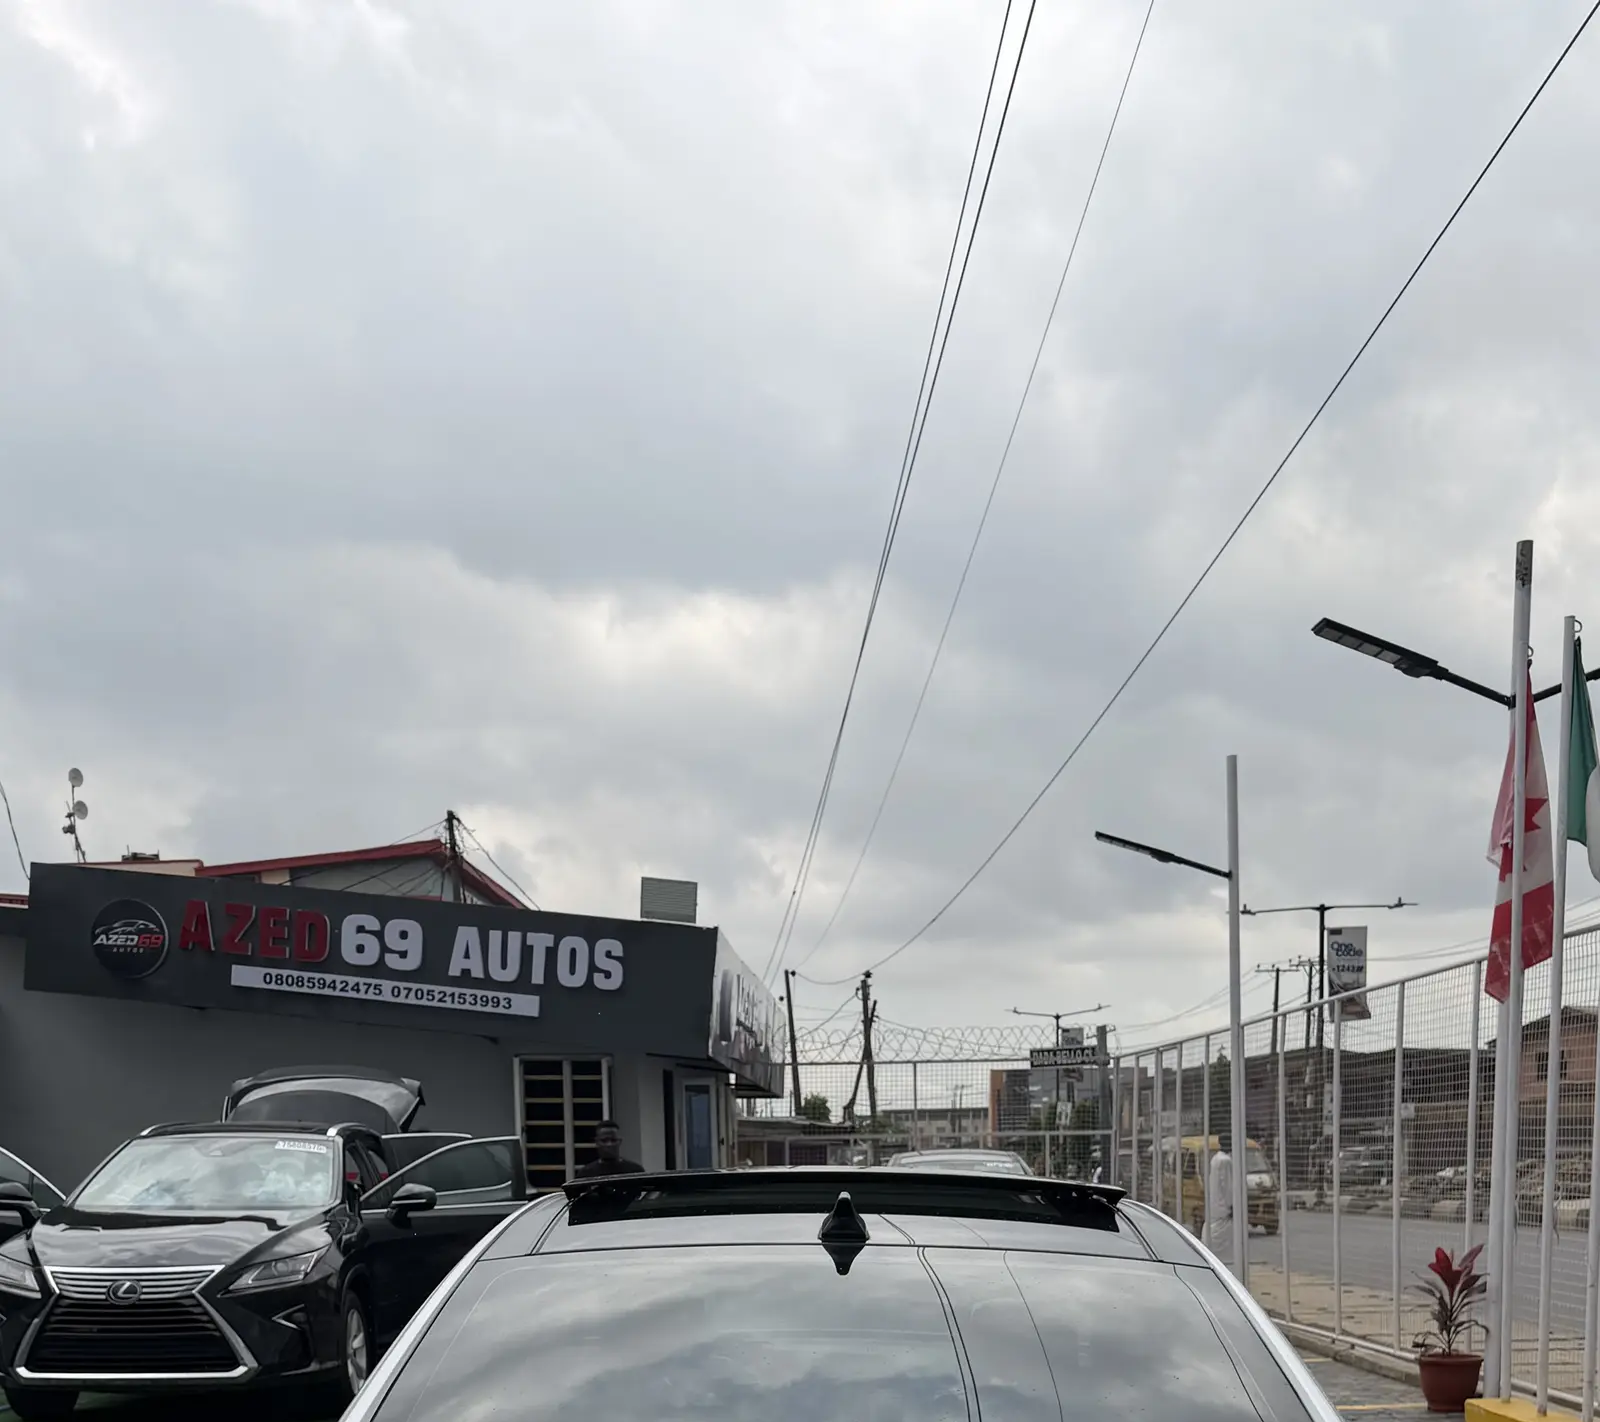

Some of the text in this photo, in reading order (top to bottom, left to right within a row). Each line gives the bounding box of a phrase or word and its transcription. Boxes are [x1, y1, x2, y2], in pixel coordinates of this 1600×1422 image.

[179, 899, 624, 991] AZED 69 AUTOS
[263, 972, 513, 1010] 08085942475 07052153993
